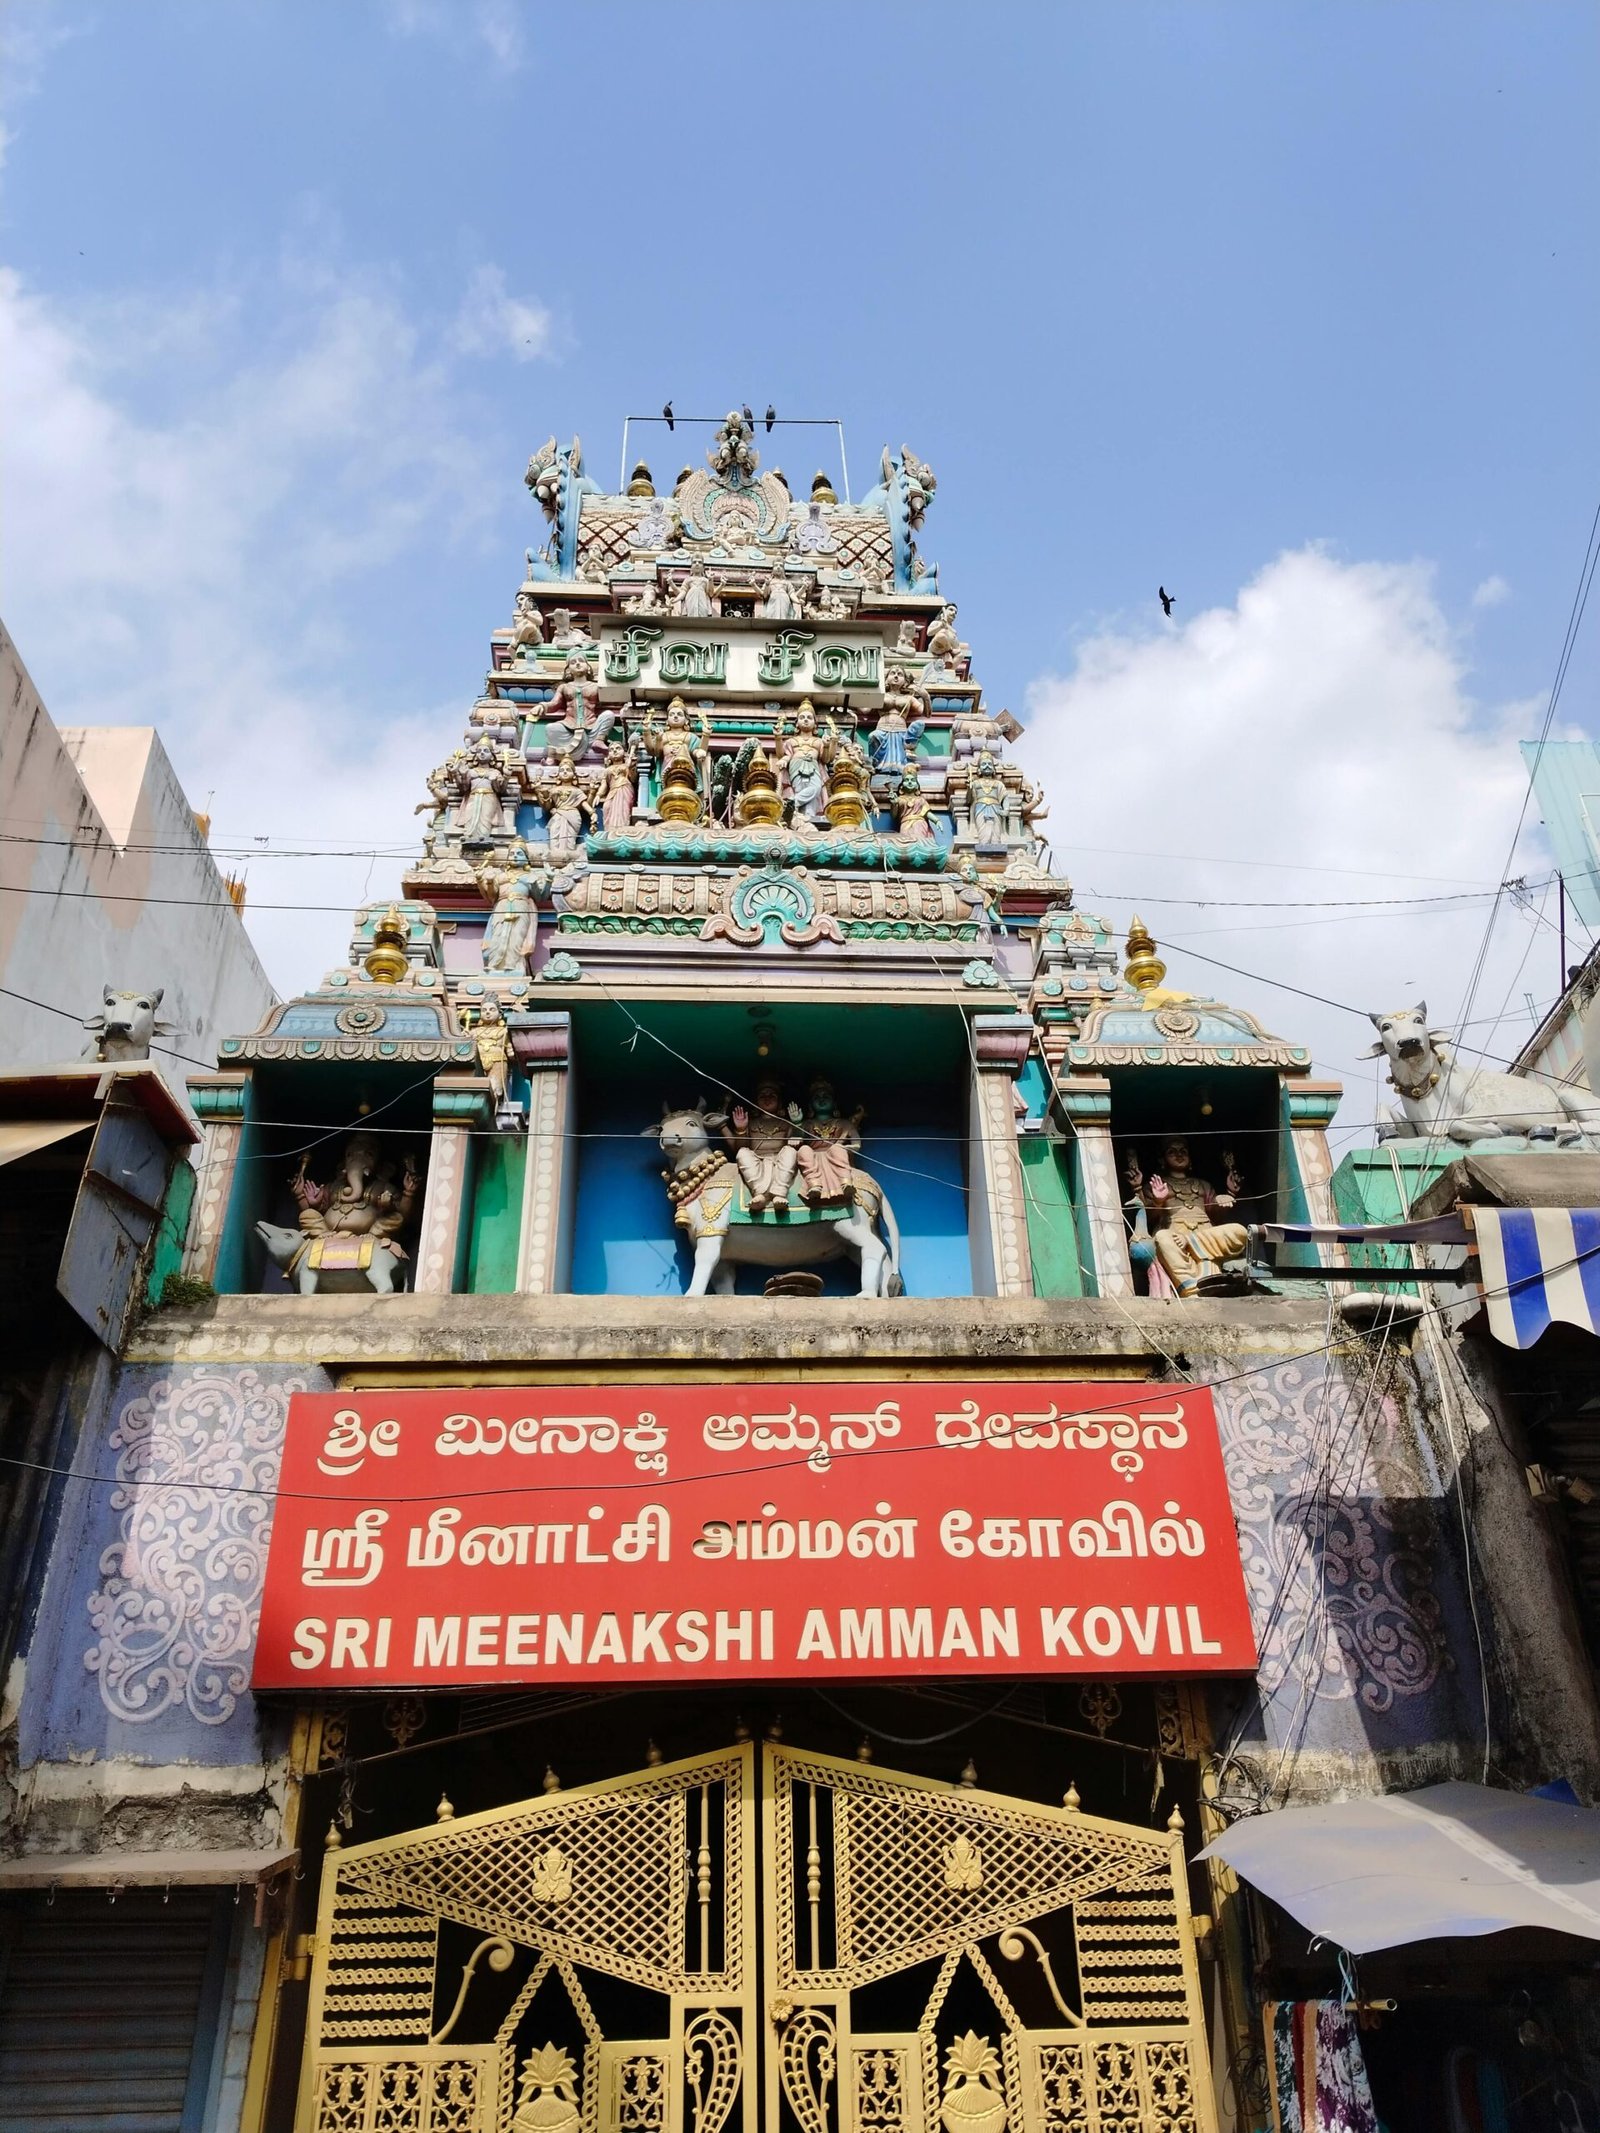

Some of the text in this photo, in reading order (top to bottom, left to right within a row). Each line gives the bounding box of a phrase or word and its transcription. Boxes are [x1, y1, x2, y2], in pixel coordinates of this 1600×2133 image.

[605, 624, 880, 687] சிவ சிவ
[317, 1400, 1189, 1483] ಶ್ರೀ ಮೀನಾಕ್ಷಿ ಅಮ್ಮನ್ ದೇವಸ್ಥಾನ
[301, 1500, 1206, 1587] ஸ்ரீ மீனாட்சி அம்மன் கோவில்
[290, 1605, 1223, 1670] SRI MEENAKSHI AMMAN KOVIL
